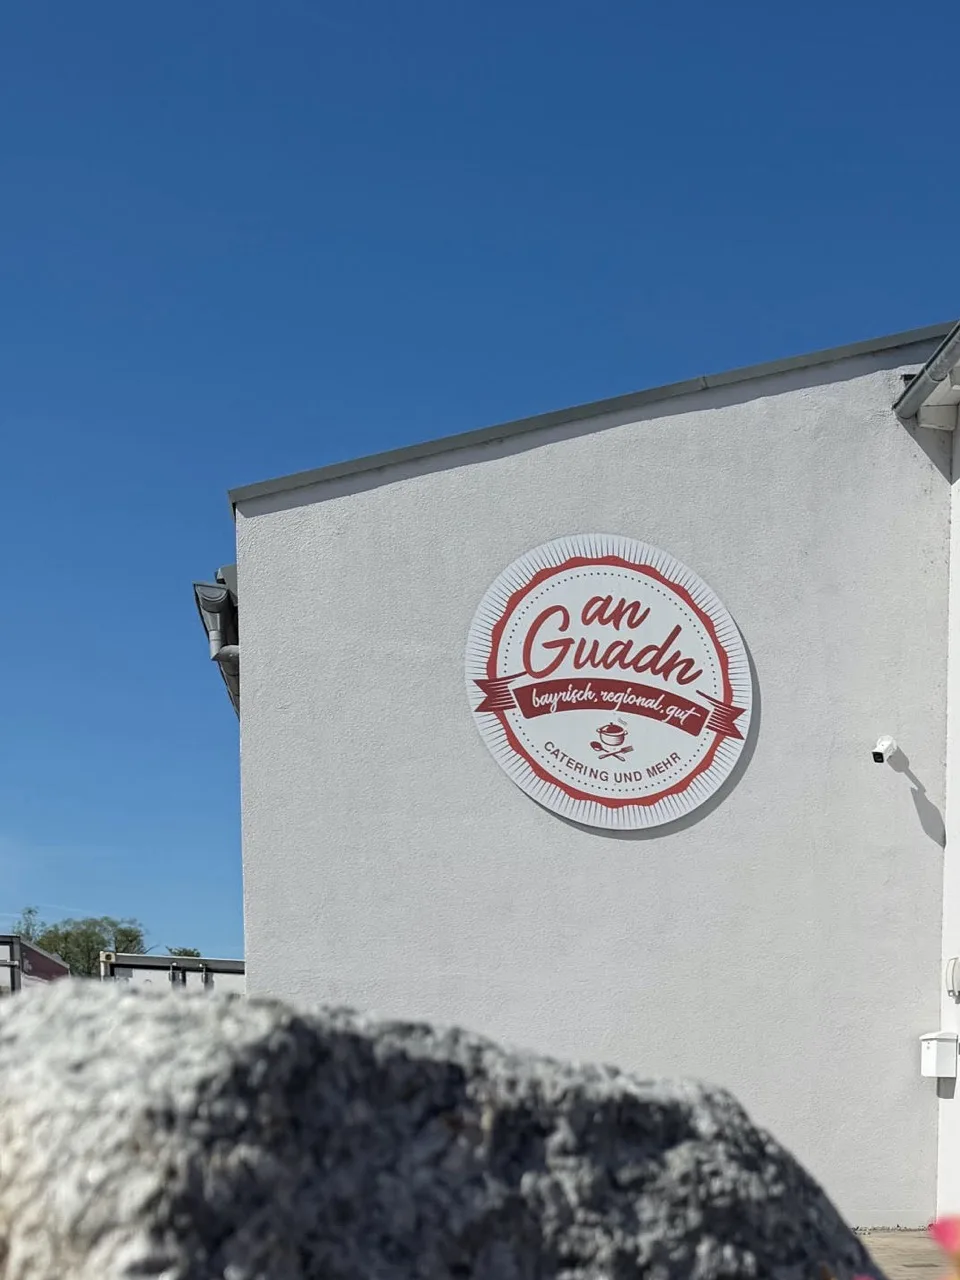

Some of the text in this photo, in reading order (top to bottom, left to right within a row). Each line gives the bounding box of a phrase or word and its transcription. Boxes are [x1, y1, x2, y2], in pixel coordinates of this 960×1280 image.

[581, 594, 650, 631] an
[522, 604, 703, 685] Guadn
[532, 682, 701, 725] bayrisch, regional, gut
[544, 741, 682, 783] CATERING UND MEHR
